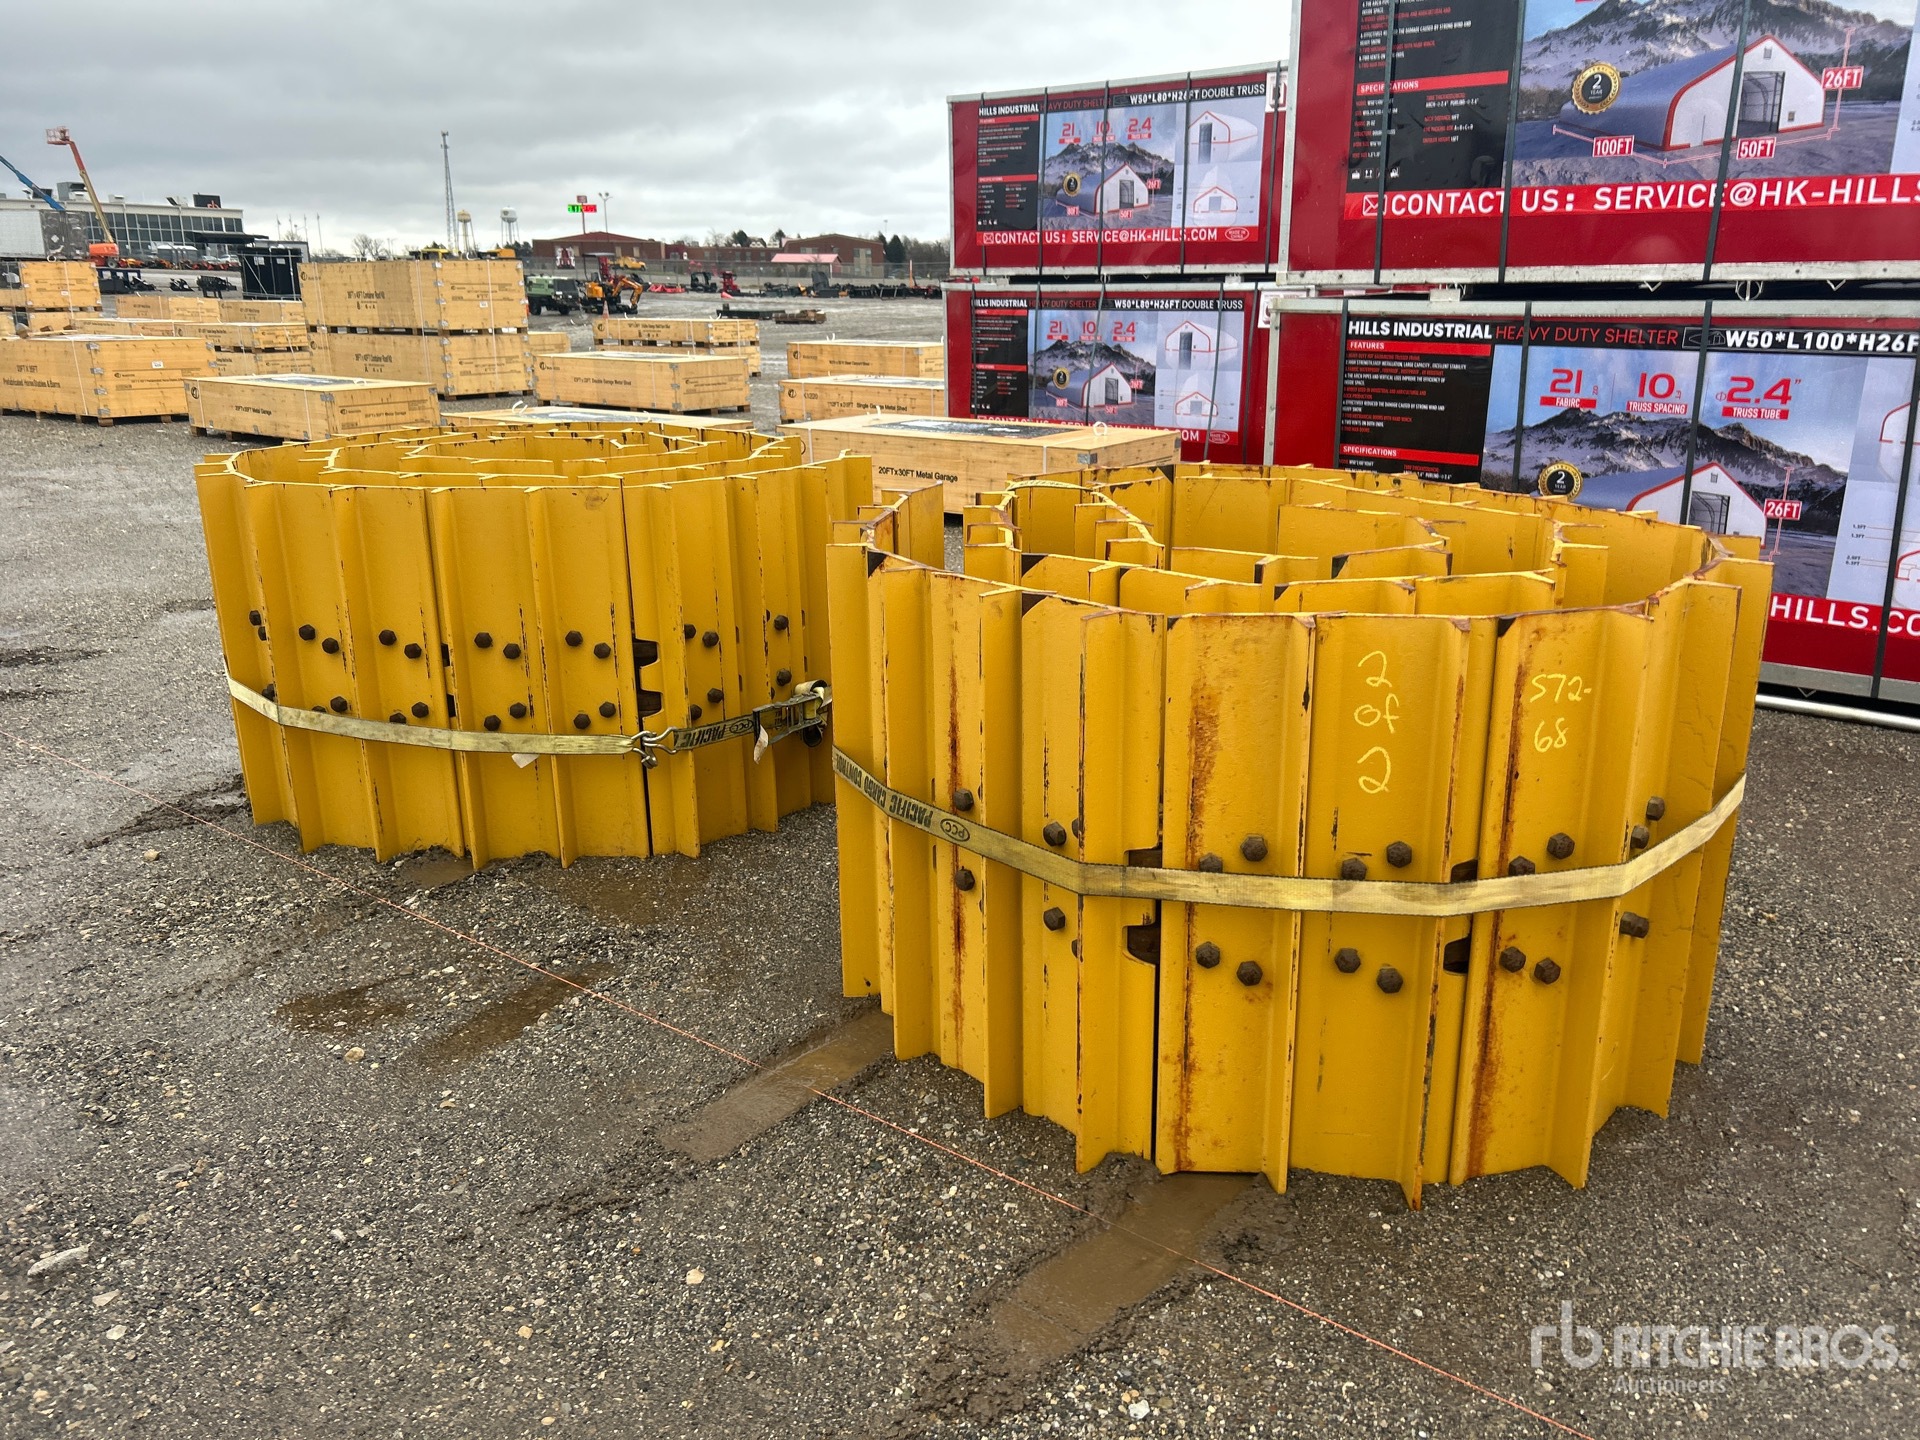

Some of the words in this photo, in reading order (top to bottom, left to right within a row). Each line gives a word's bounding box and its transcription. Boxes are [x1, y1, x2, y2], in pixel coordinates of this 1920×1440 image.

[1593, 74, 1602, 89] 2
[1824, 68, 1862, 88] 26FT
[979, 106, 997, 116] HILLS
[998, 104, 1039, 115] INDUSTRIAL
[1041, 101, 1061, 111] HAVY
[1064, 100, 1081, 109] DUTY
[1202, 87, 1234, 99] DOUBLE
[1237, 84, 1265, 96] TRUSS
[1062, 123, 1074, 136] 21
[1096, 121, 1110, 134] 10
[1596, 137, 1632, 156] 100FT
[1740, 138, 1774, 158] 50FT
[1392, 190, 1504, 215] CONTACT
[1522, 190, 1574, 212] US:
[995, 232, 1040, 244] CONTACT
[1045, 232, 1065, 243] US:
[1182, 300, 1214, 309] DOUBLE
[1216, 300, 1243, 309] TRUSS
[1050, 321, 1062, 333] 21
[1083, 322, 1096, 333] 10
[1348, 321, 1390, 335] HILLS
[1393, 322, 1492, 339] INDUSTRIAL
[1495, 326, 1550, 342] HEAVY
[1555, 327, 1600, 342] DUTY
[1604, 328, 1678, 345] SHELTER
[1550, 368, 1583, 395] 21
[1637, 372, 1675, 399] 10
[1555, 398, 1580, 407] FABIRC
[1629, 402, 1651, 412] TRUSS
[1654, 403, 1685, 414] SPACING
[1732, 408, 1759, 418] TRUSS
[1760, 409, 1781, 419] TUBE
[1343, 446, 1397, 456] SPECIFICATIONS
[878, 466, 914, 477] 20FTx30FT
[916, 470, 933, 479] Metal
[934, 472, 958, 483] Garage
[1556, 471, 1565, 484] 2
[1766, 501, 1800, 518] 26FT
[1358, 650, 1392, 687] 2
[1534, 717, 1568, 752] 68
[836, 754, 863, 788] CONTROL
[1357, 746, 1392, 794] 2
[864, 777, 886, 808] CARGO
[889, 794, 933, 828] PACIFIC
[945, 822, 965, 839] PCC
